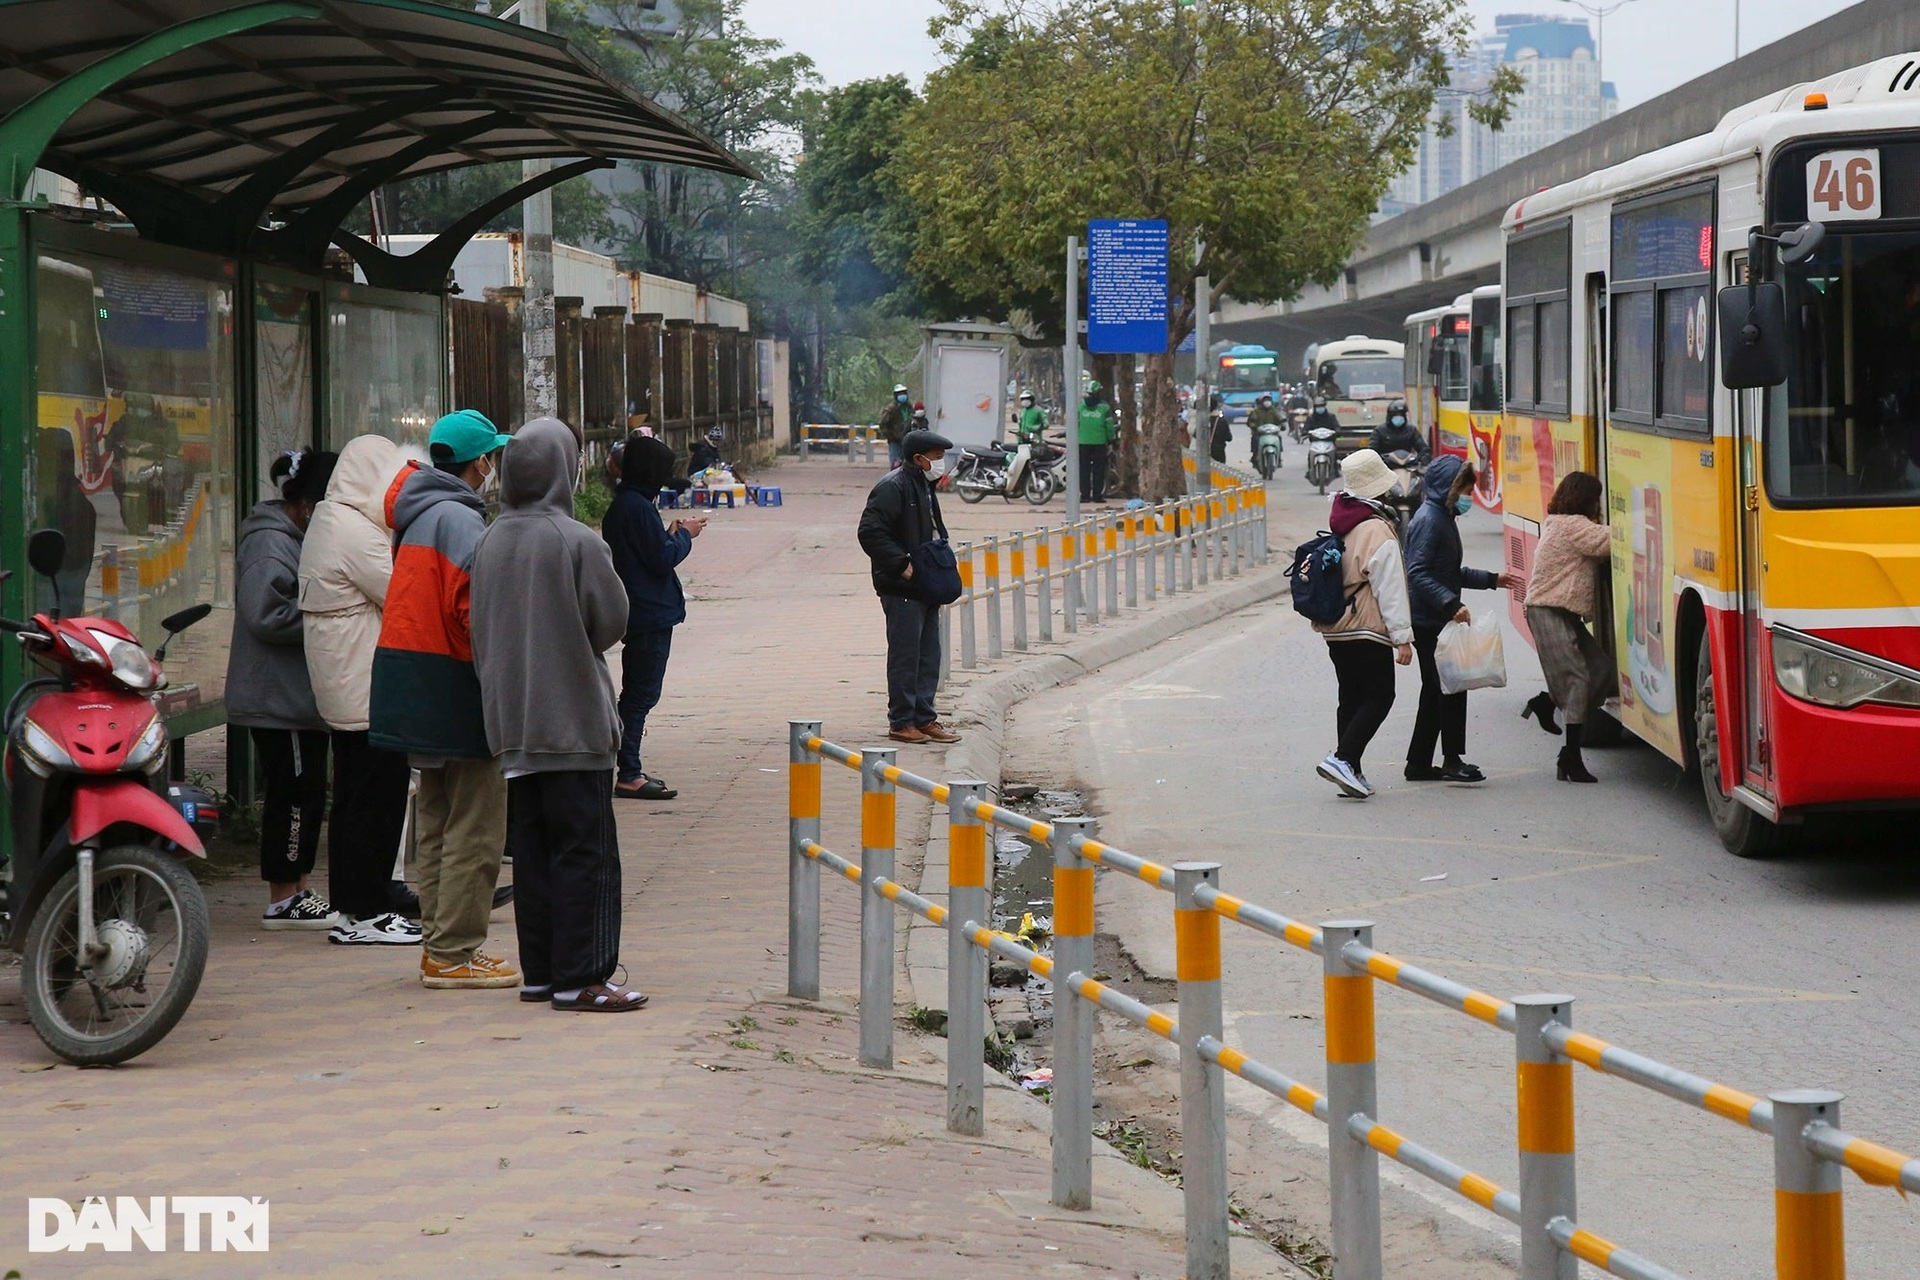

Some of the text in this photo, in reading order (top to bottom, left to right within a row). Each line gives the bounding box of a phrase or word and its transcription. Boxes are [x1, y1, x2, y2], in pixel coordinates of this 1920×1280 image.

[1813, 157, 1875, 212] 46
[1082, 410, 1102, 418] Grab
[77, 703, 113, 711] HONDA
